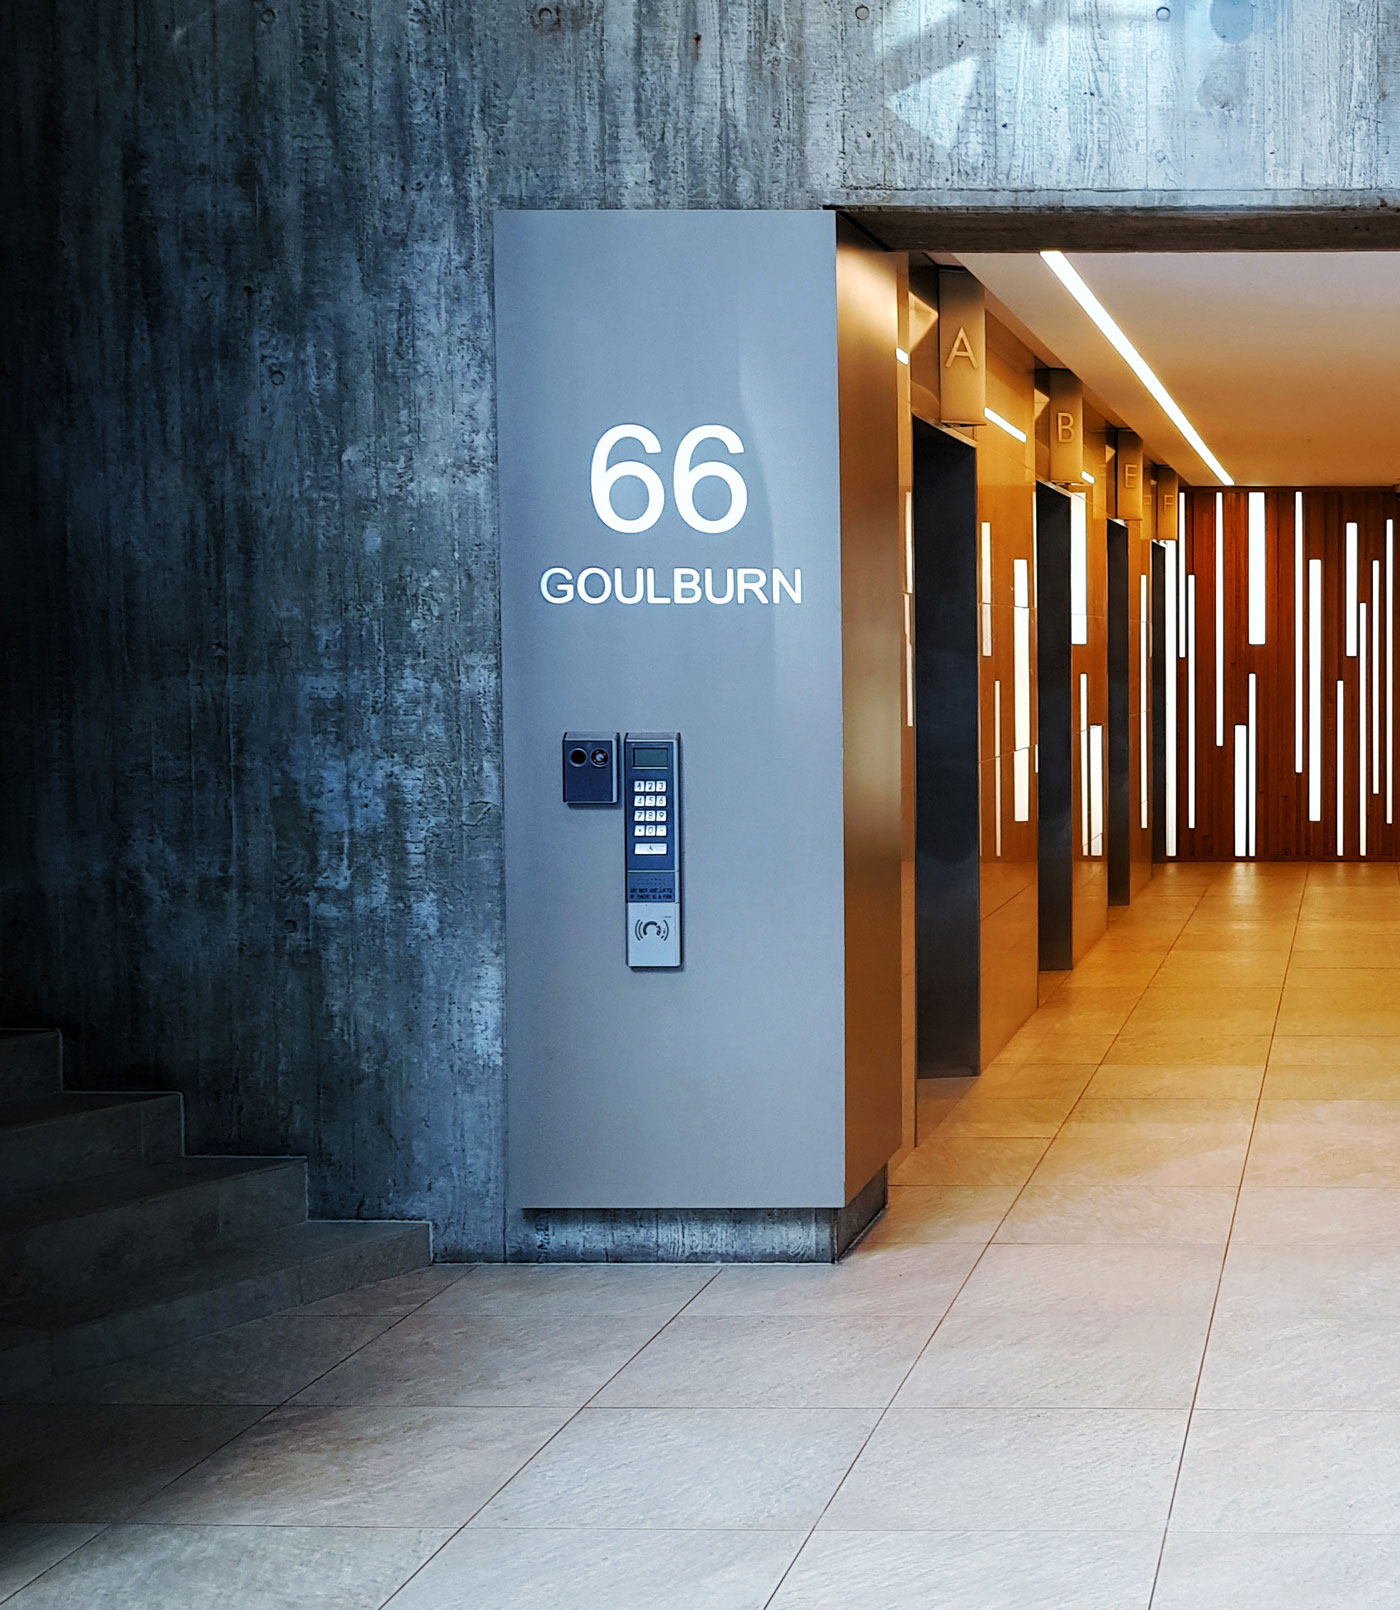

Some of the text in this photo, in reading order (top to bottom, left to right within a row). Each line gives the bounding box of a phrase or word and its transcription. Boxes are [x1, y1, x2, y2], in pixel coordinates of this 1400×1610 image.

[945, 326, 977, 369] A
[1057, 412, 1075, 443] B
[590, 423, 748, 534] 66
[1124, 463, 1138, 488] E
[1164, 494, 1174, 514] F
[540, 566, 802, 605] GOULBURN
